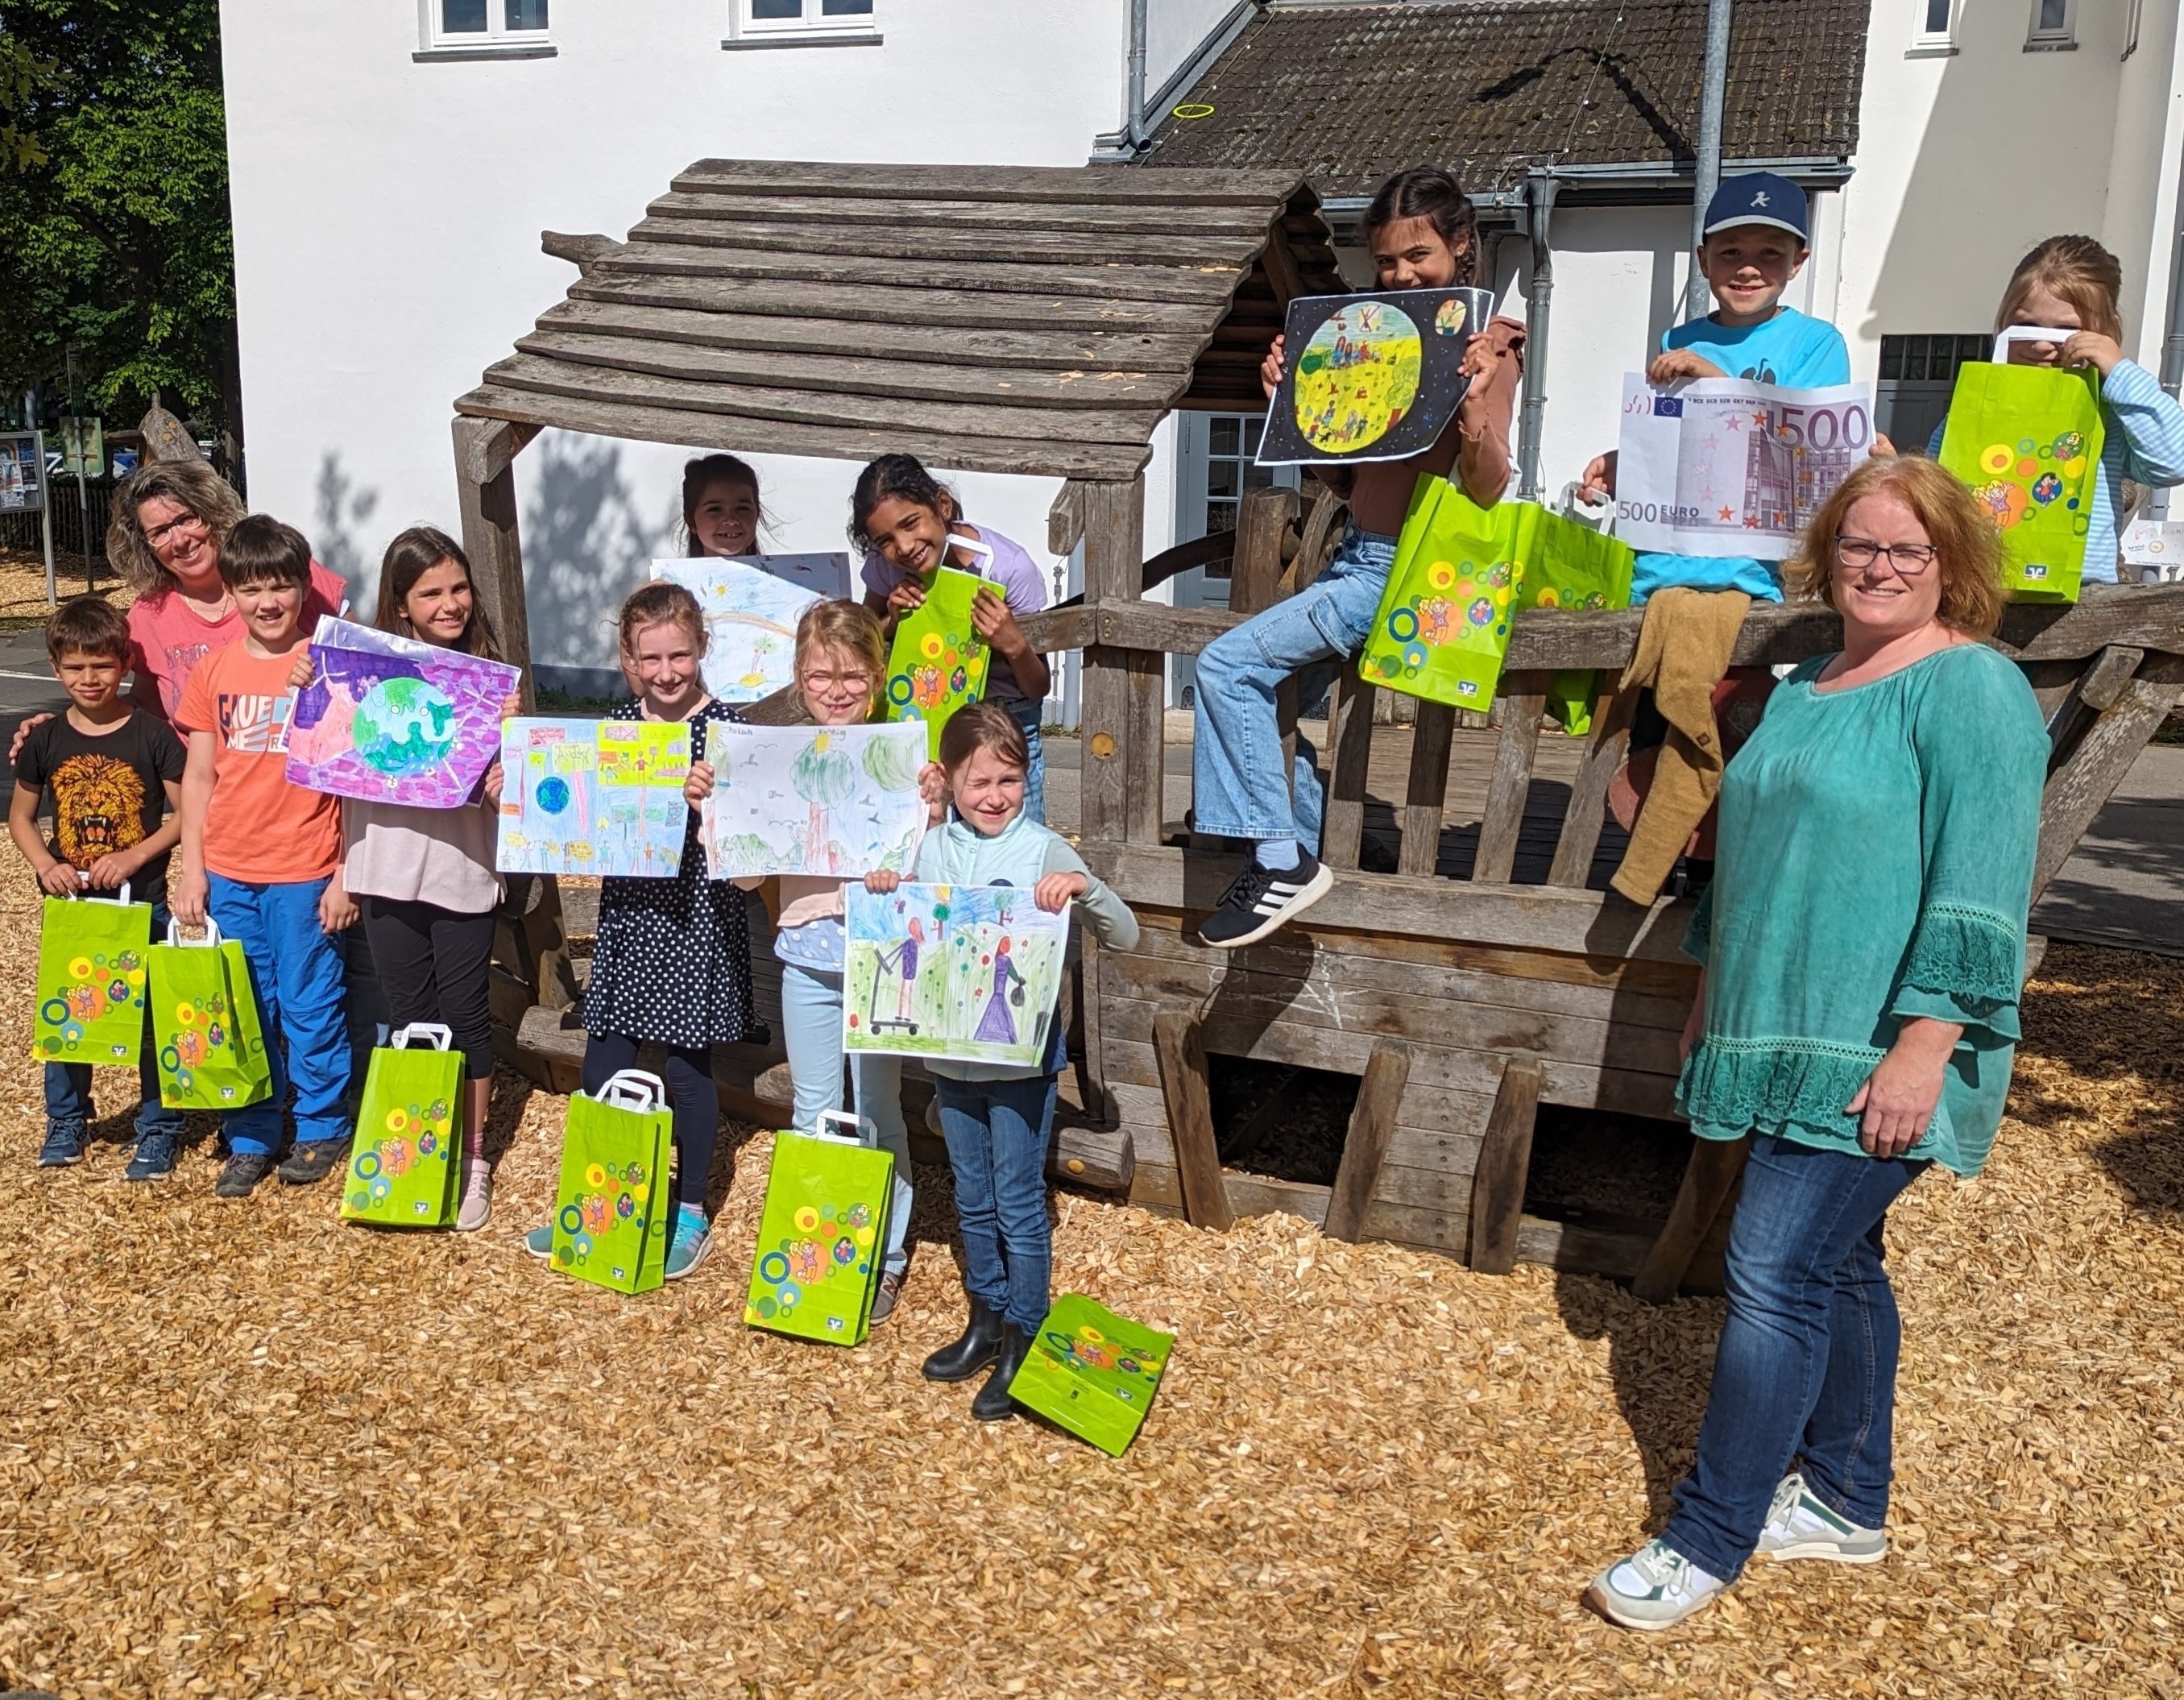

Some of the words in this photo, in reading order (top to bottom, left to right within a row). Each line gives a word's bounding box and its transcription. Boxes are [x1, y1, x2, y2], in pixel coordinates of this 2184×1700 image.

[1781, 404, 1868, 452] 500
[1618, 500, 1657, 523] 500
[1660, 504, 1700, 517] EURO
